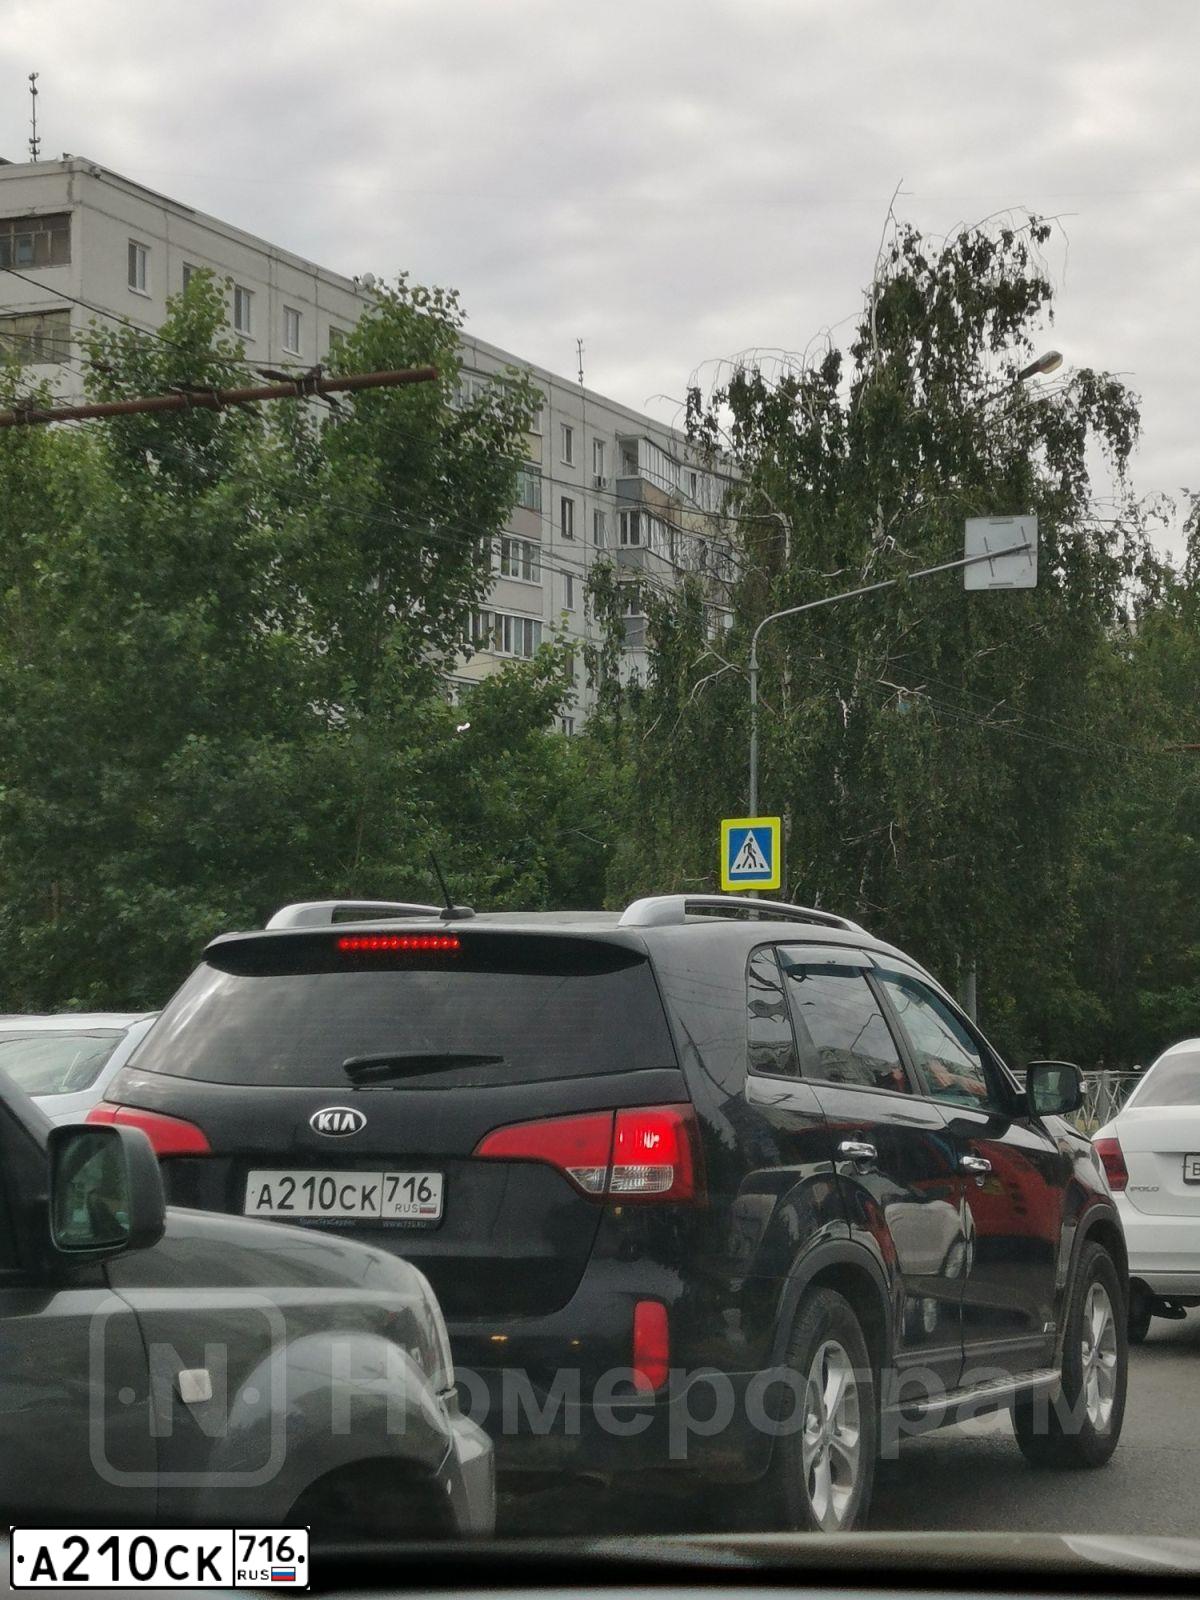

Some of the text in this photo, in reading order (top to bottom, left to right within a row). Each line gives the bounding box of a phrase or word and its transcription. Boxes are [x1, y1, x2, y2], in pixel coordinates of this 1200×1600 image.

[318, 1113, 356, 1131] KIA
[386, 1176, 432, 1203] 716
[394, 1204, 418, 1213] RUS
